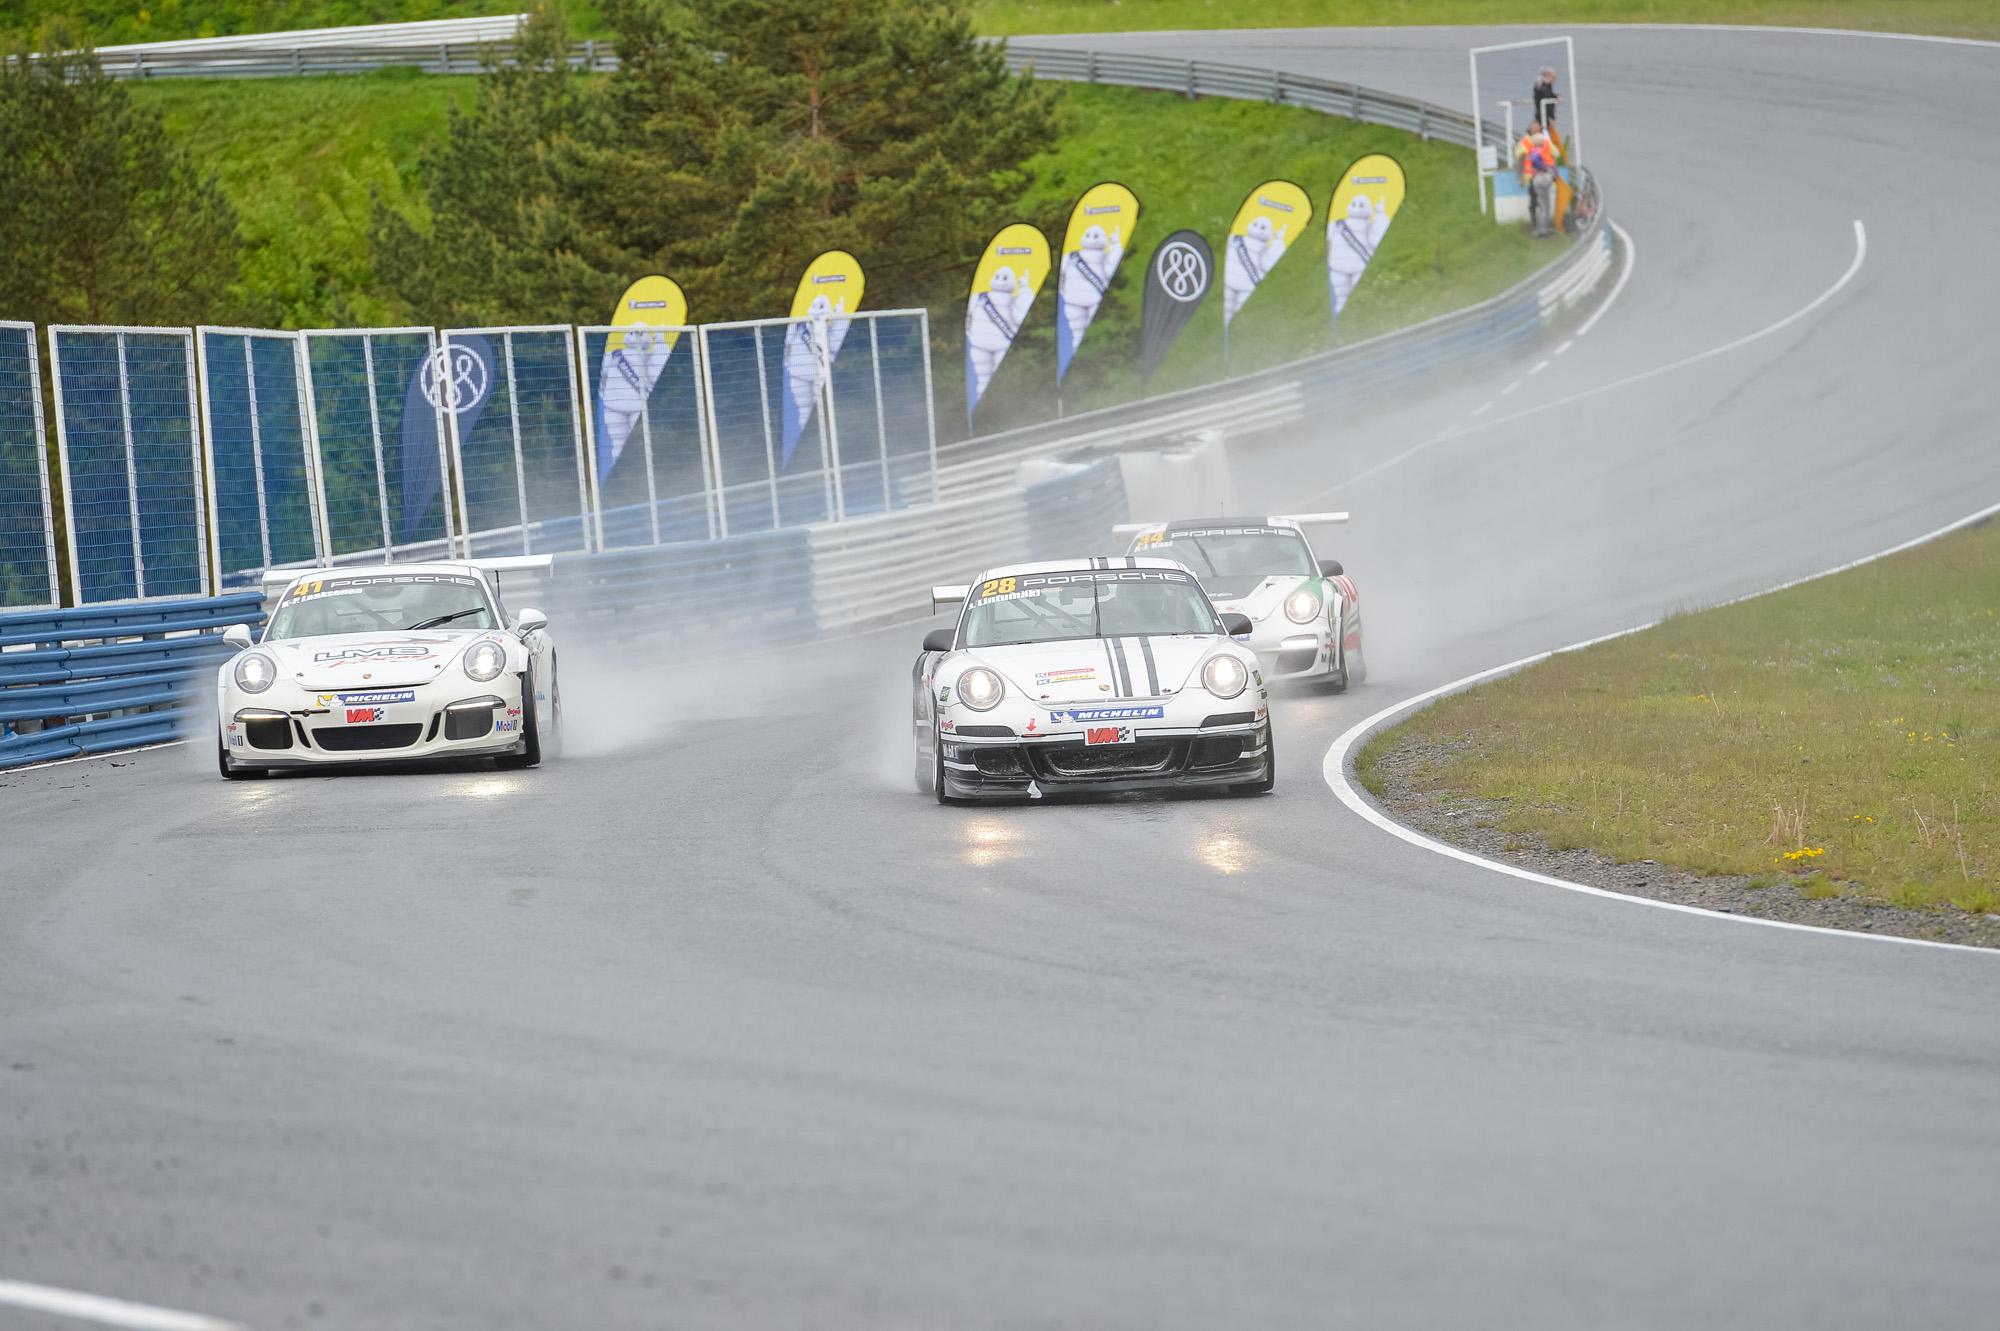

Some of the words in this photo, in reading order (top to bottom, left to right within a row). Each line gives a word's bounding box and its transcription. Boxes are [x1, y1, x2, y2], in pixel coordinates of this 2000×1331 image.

[1136, 531, 1164, 546] 34
[1171, 528, 1296, 539] PORSCHE
[293, 581, 323, 596] 41
[331, 576, 476, 587] PORSCHE
[982, 577, 1016, 598] 28
[1023, 572, 1188, 587] PORSCHE
[301, 588, 363, 602] Laaksonen
[345, 692, 414, 703] MICHELIN
[346, 708, 375, 723] VM
[1077, 708, 1160, 719] MICHELIN
[496, 721, 513, 731] Mobil
[1087, 727, 1120, 744] VM
